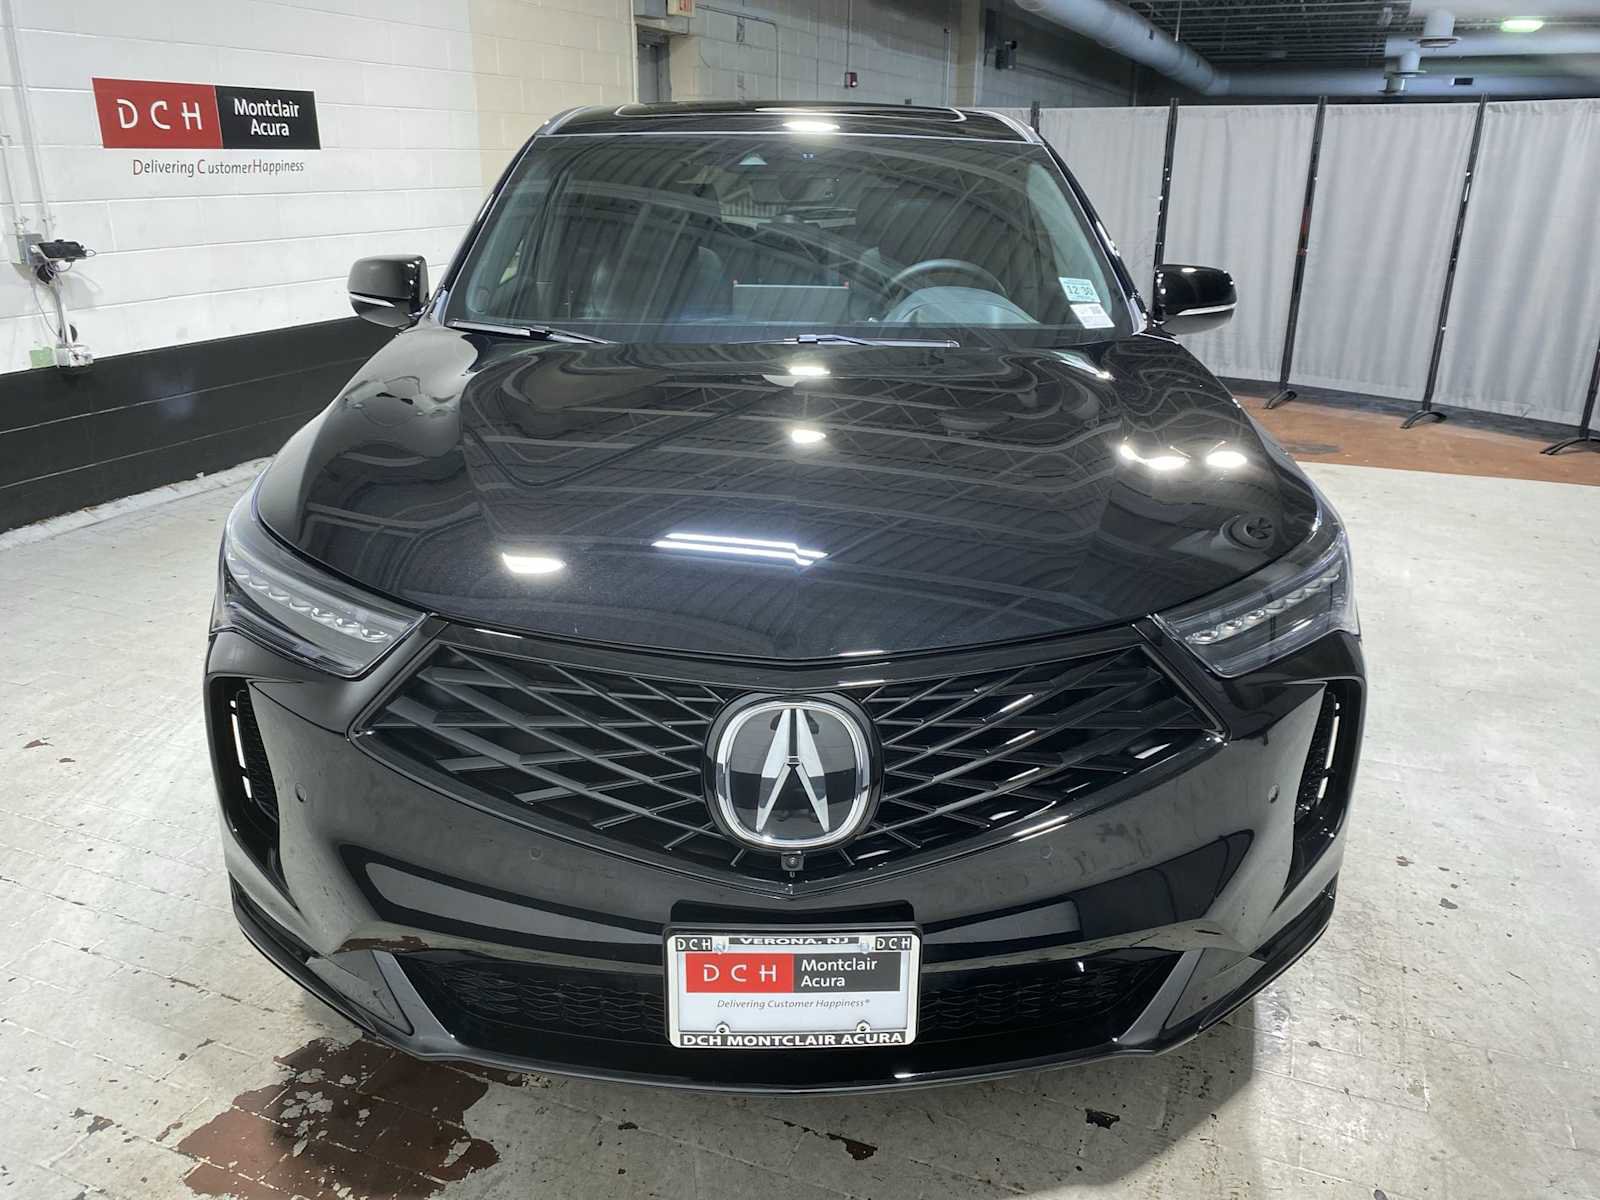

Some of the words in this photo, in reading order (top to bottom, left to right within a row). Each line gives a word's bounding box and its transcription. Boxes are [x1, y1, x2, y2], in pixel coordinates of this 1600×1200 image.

[234, 97, 300, 118] Montclair
[250, 118, 289, 136] Acura
[133, 159, 194, 177] Delivering
[252, 159, 304, 175] Happiness
[677, 938, 712, 951] DCH
[876, 937, 911, 949] DCH
[801, 957, 877, 971] Montclair
[703, 964, 777, 982] DCH
[801, 975, 845, 987] Acura
[717, 999, 766, 1009] Delivering
[768, 999, 814, 1008] Customer
[683, 1035, 721, 1046] DCH
[727, 1034, 836, 1046] MONTCLAIR
[841, 1032, 903, 1045] ACURA
